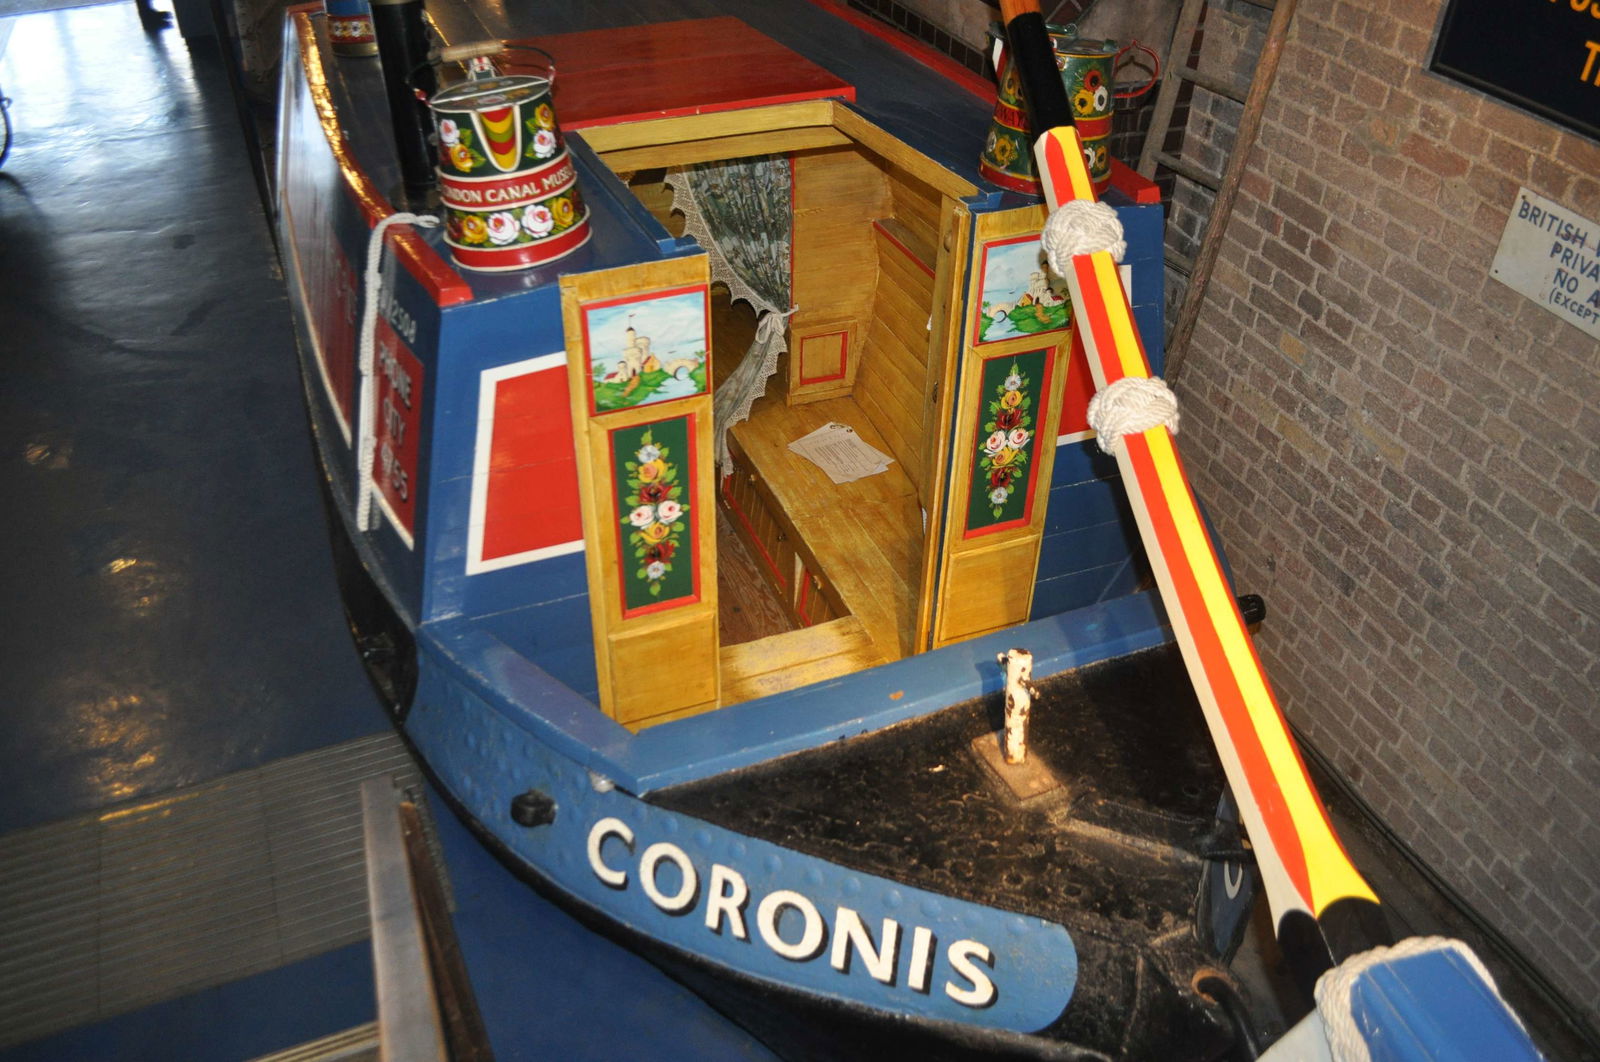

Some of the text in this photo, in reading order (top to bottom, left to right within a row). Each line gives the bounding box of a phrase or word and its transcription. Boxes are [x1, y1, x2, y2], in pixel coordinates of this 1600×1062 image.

[485, 181, 541, 203] CANAL
[1518, 200, 1588, 249] BRITISH
[1553, 267, 1579, 294] NO
[586, 816, 998, 1009] CORONIS
